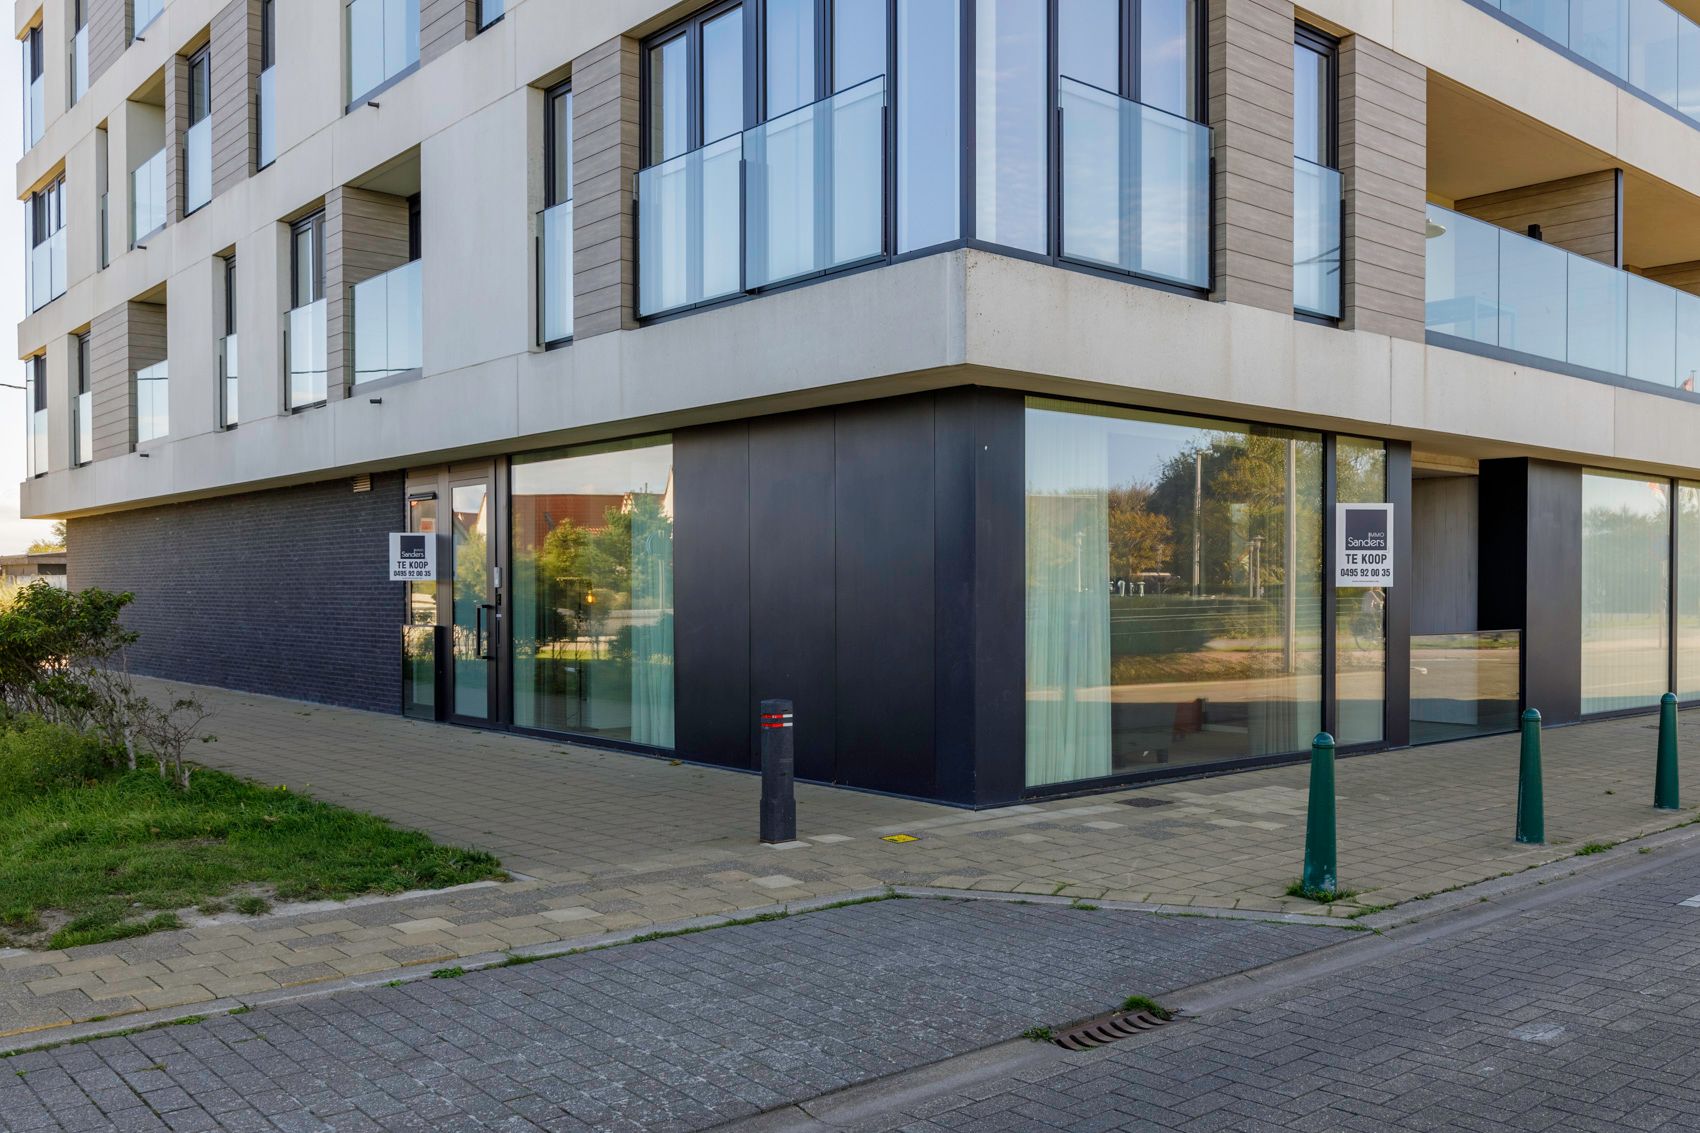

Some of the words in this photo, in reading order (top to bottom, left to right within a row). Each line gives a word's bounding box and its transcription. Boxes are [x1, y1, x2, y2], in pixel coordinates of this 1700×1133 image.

[1348, 535, 1385, 547] Sanders
[1345, 554, 1358, 564] TE
[1361, 554, 1387, 564] KOOP
[1340, 568, 1358, 577] 0495
[1360, 568, 1369, 577] 92
[1370, 568, 1380, 577] 00
[1381, 568, 1391, 577] 35
